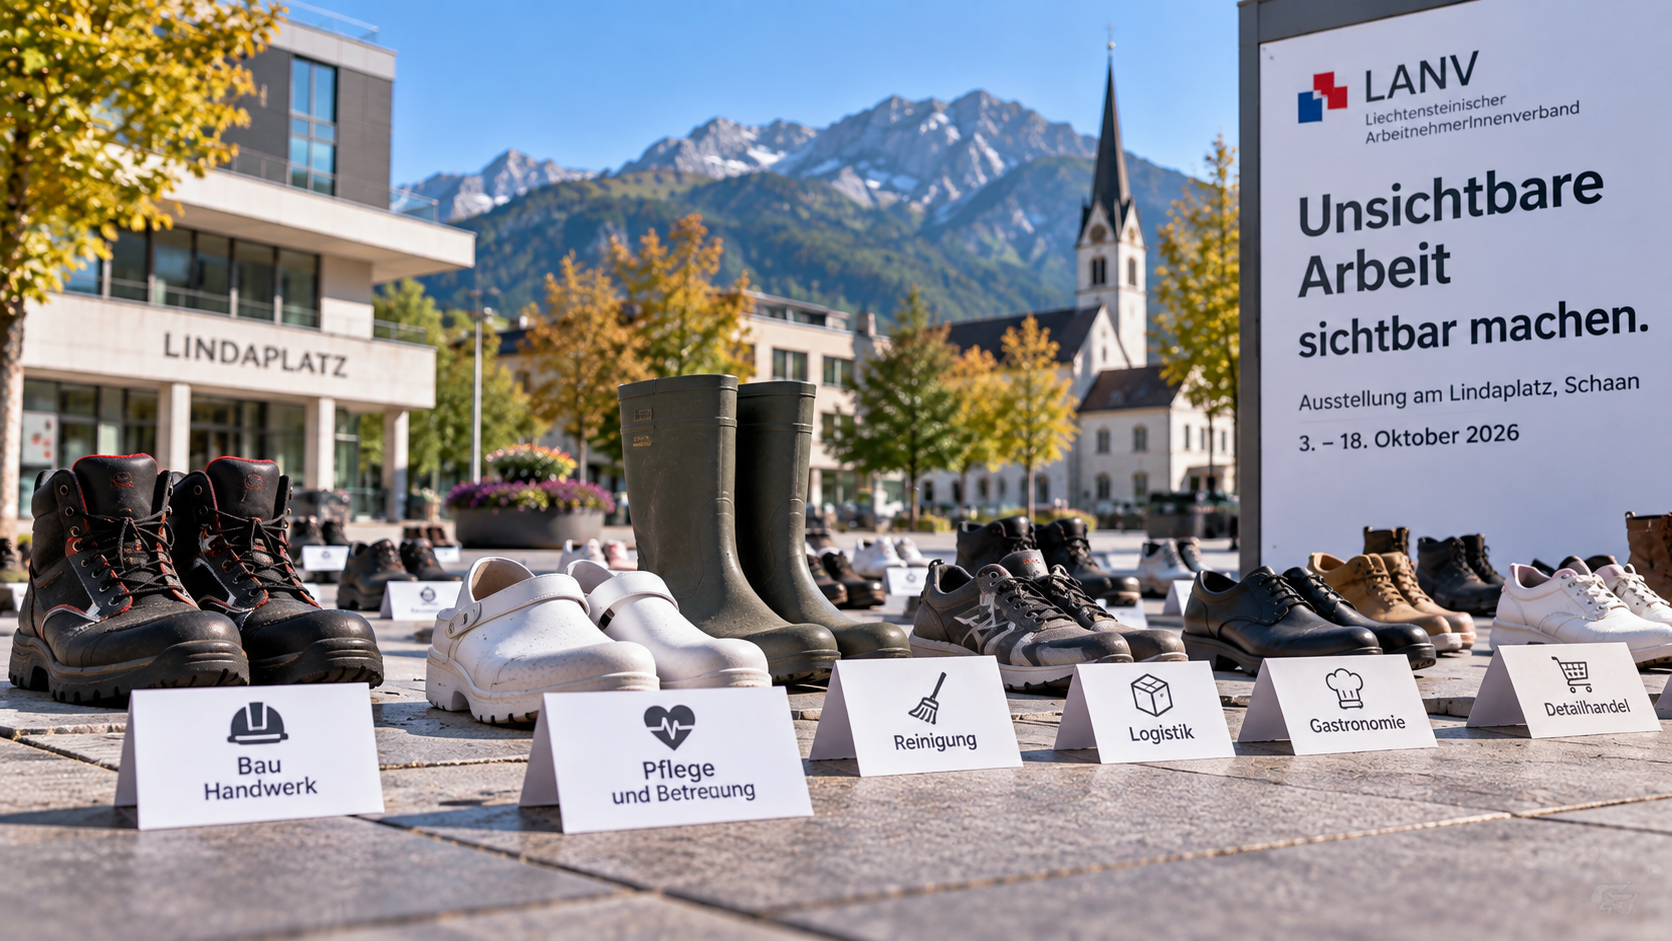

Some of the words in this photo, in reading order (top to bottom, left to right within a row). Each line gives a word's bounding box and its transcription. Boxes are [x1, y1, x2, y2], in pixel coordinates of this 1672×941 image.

[1365, 50, 1480, 103] LANV
[1365, 94, 1507, 126] Liechtensteinischer
[1365, 100, 1581, 145] ArbeitnehmerInnenverband
[1299, 169, 1604, 237] Unsichtbare
[1298, 241, 1452, 298] Arbeit
[1298, 315, 1457, 359] sichtbar
[1470, 301, 1649, 345] machen.
[164, 332, 348, 378] LINDAPLATZ
[1299, 389, 1407, 410] Ausstellung
[1413, 388, 1443, 404] am
[1450, 379, 1558, 403] Lindaplatz,
[1564, 374, 1640, 394] Schaan
[1299, 435, 1316, 452] 3.
[1340, 432, 1369, 450] 18.
[1374, 426, 1460, 448] Oktober
[1466, 423, 1520, 444] 2026
[1544, 698, 1631, 717] Detailhandel
[1128, 723, 1195, 745] Logistik
[1309, 714, 1406, 733] Gastronomie
[893, 733, 977, 753] Reinigung
[237, 756, 282, 776] Bau
[642, 759, 716, 783] Pflege
[204, 776, 318, 801] Handwerk
[612, 785, 650, 805] und
